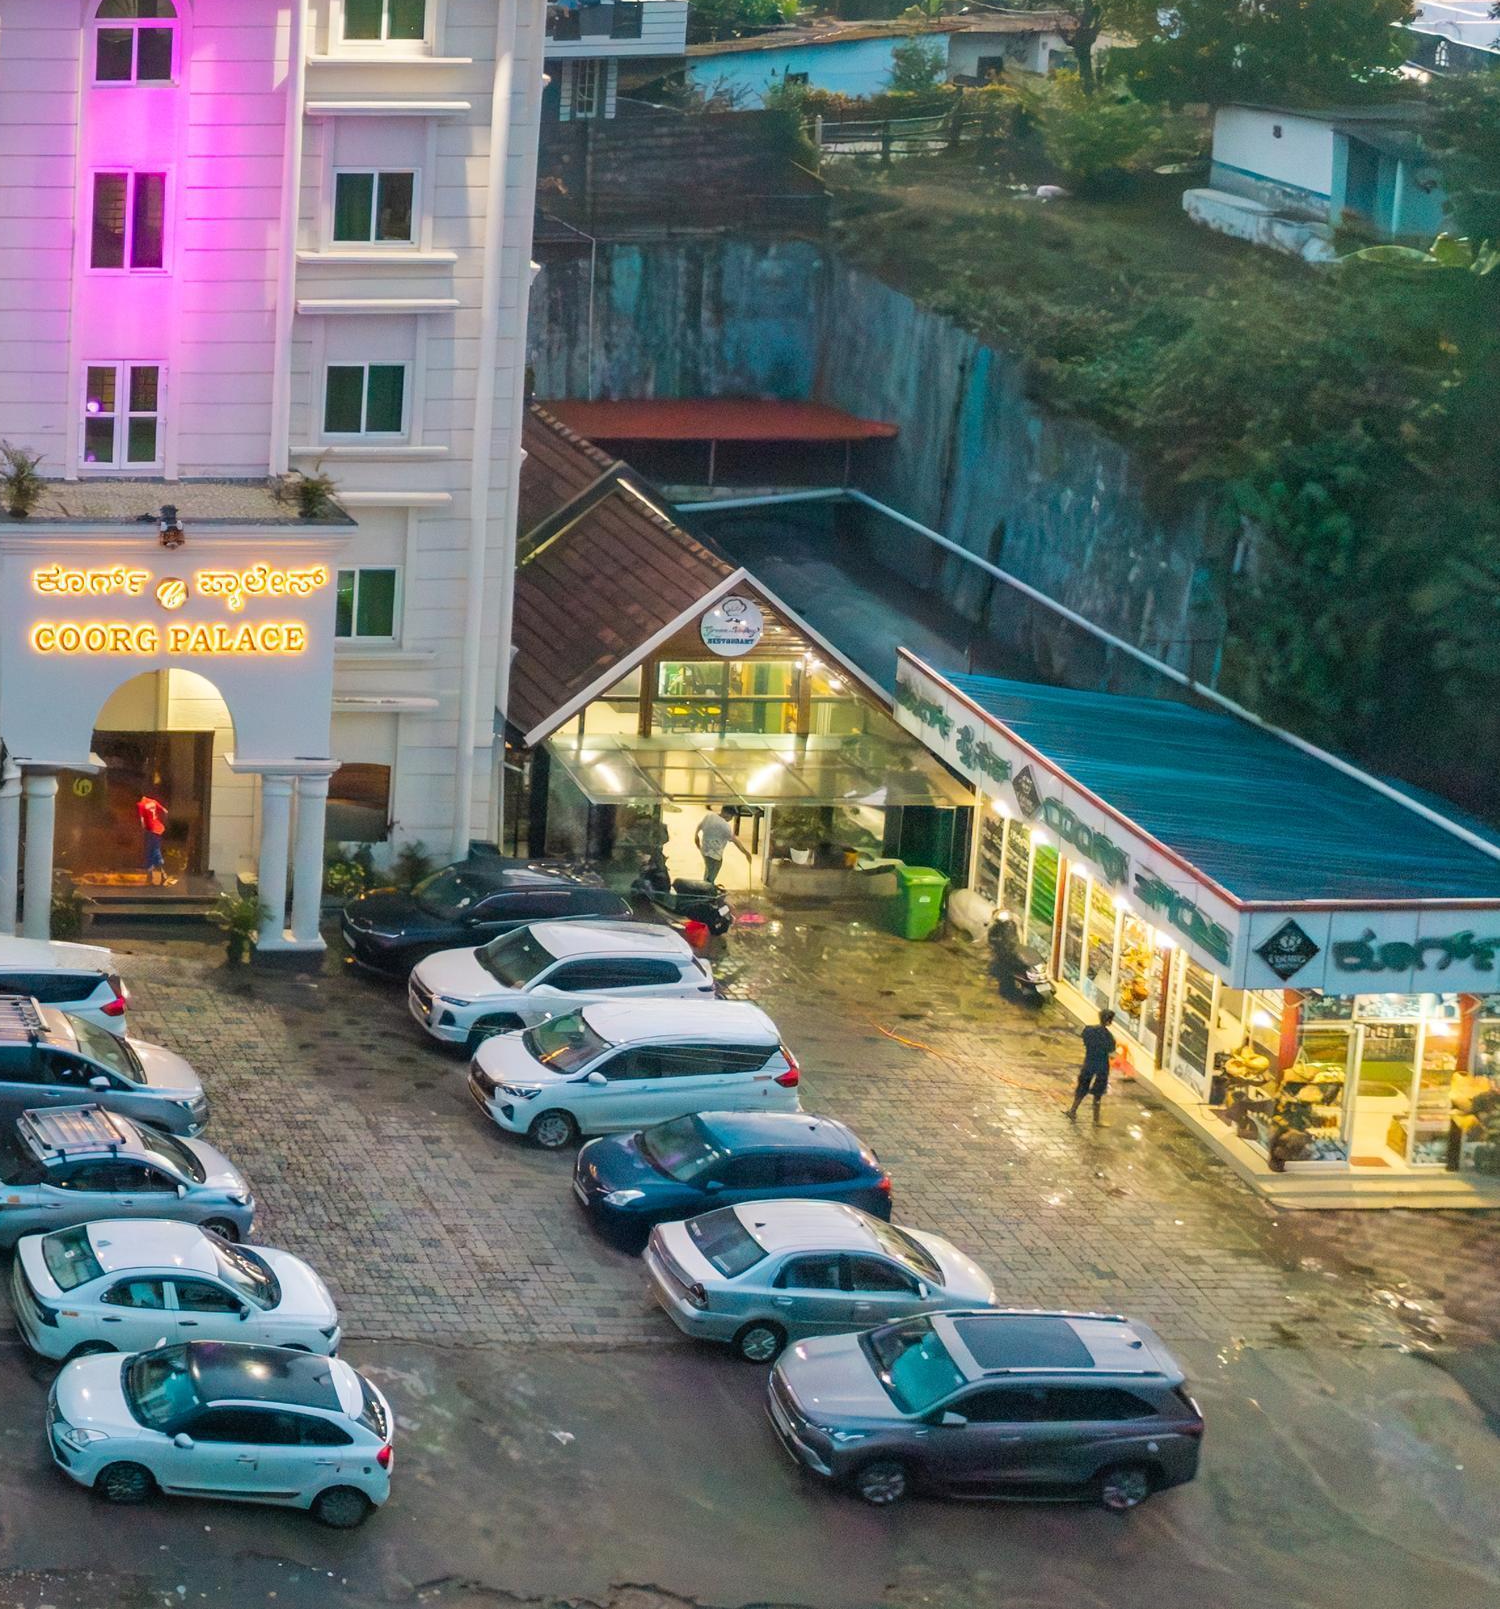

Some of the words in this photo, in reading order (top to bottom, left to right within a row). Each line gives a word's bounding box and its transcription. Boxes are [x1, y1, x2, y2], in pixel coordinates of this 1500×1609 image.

[32, 566, 149, 596] ಕೂರ್ಗ್
[198, 565, 328, 611] ಪ್ಯಾಲೇಸ್
[32, 625, 159, 653] COORG
[168, 626, 306, 654] PALACE
